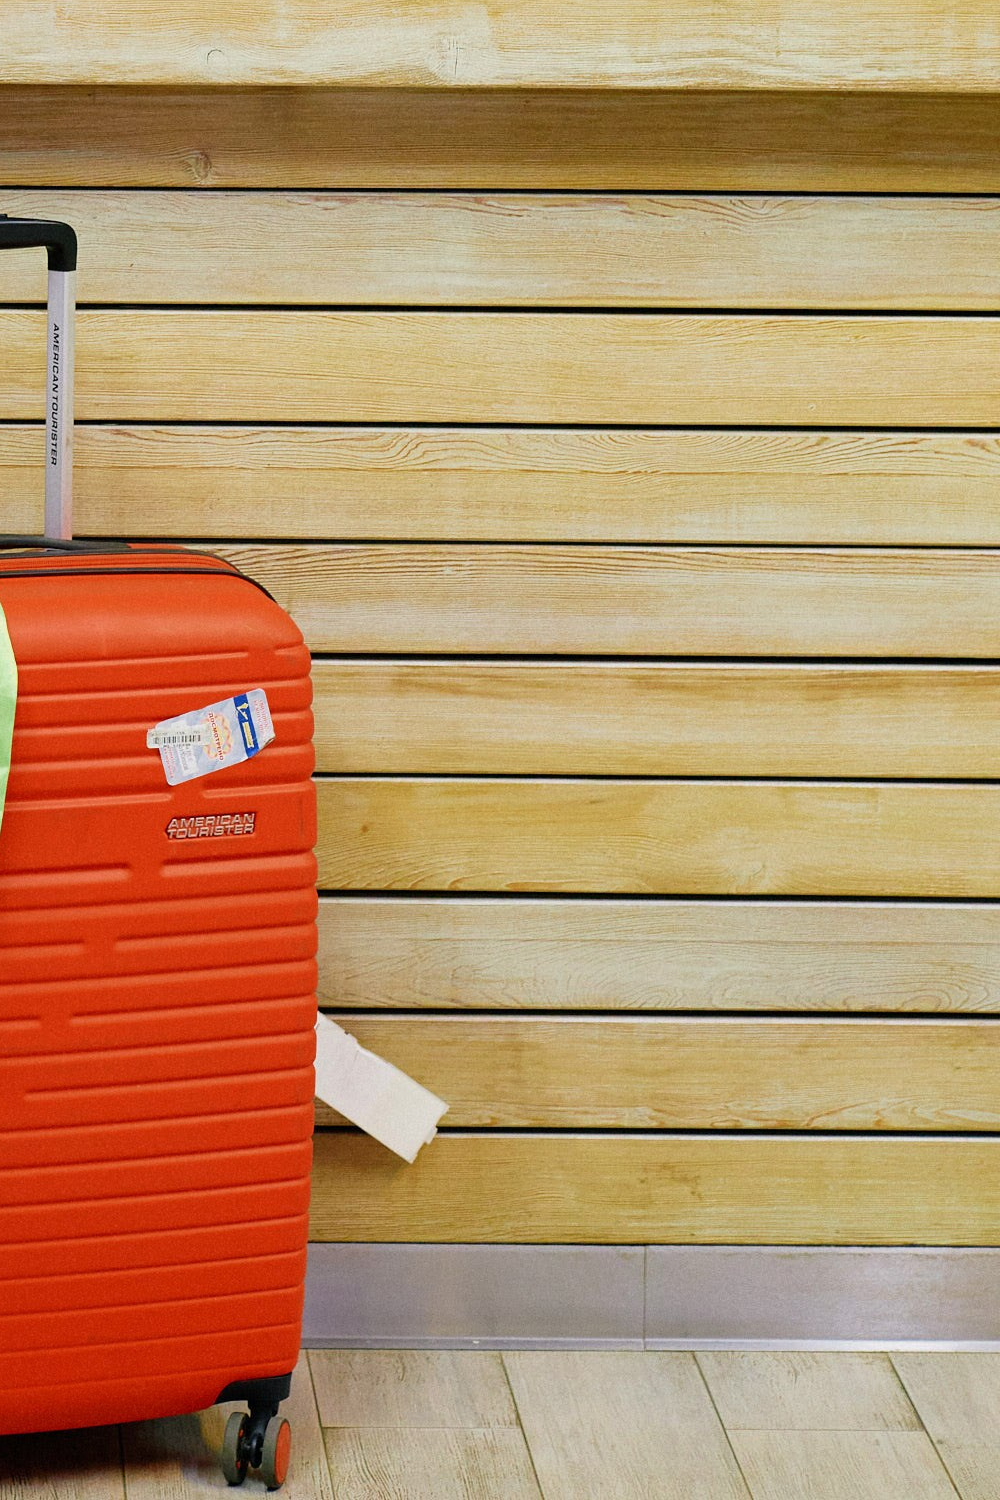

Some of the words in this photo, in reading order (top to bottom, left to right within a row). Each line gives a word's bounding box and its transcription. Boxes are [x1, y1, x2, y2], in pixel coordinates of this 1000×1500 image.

[52, 323, 60, 393] AMERICAN
[208, 712, 224, 761] ДОСМОТРЕНО
[167, 824, 254, 839] TOURISTER
[168, 813, 255, 828] AMERICAN
